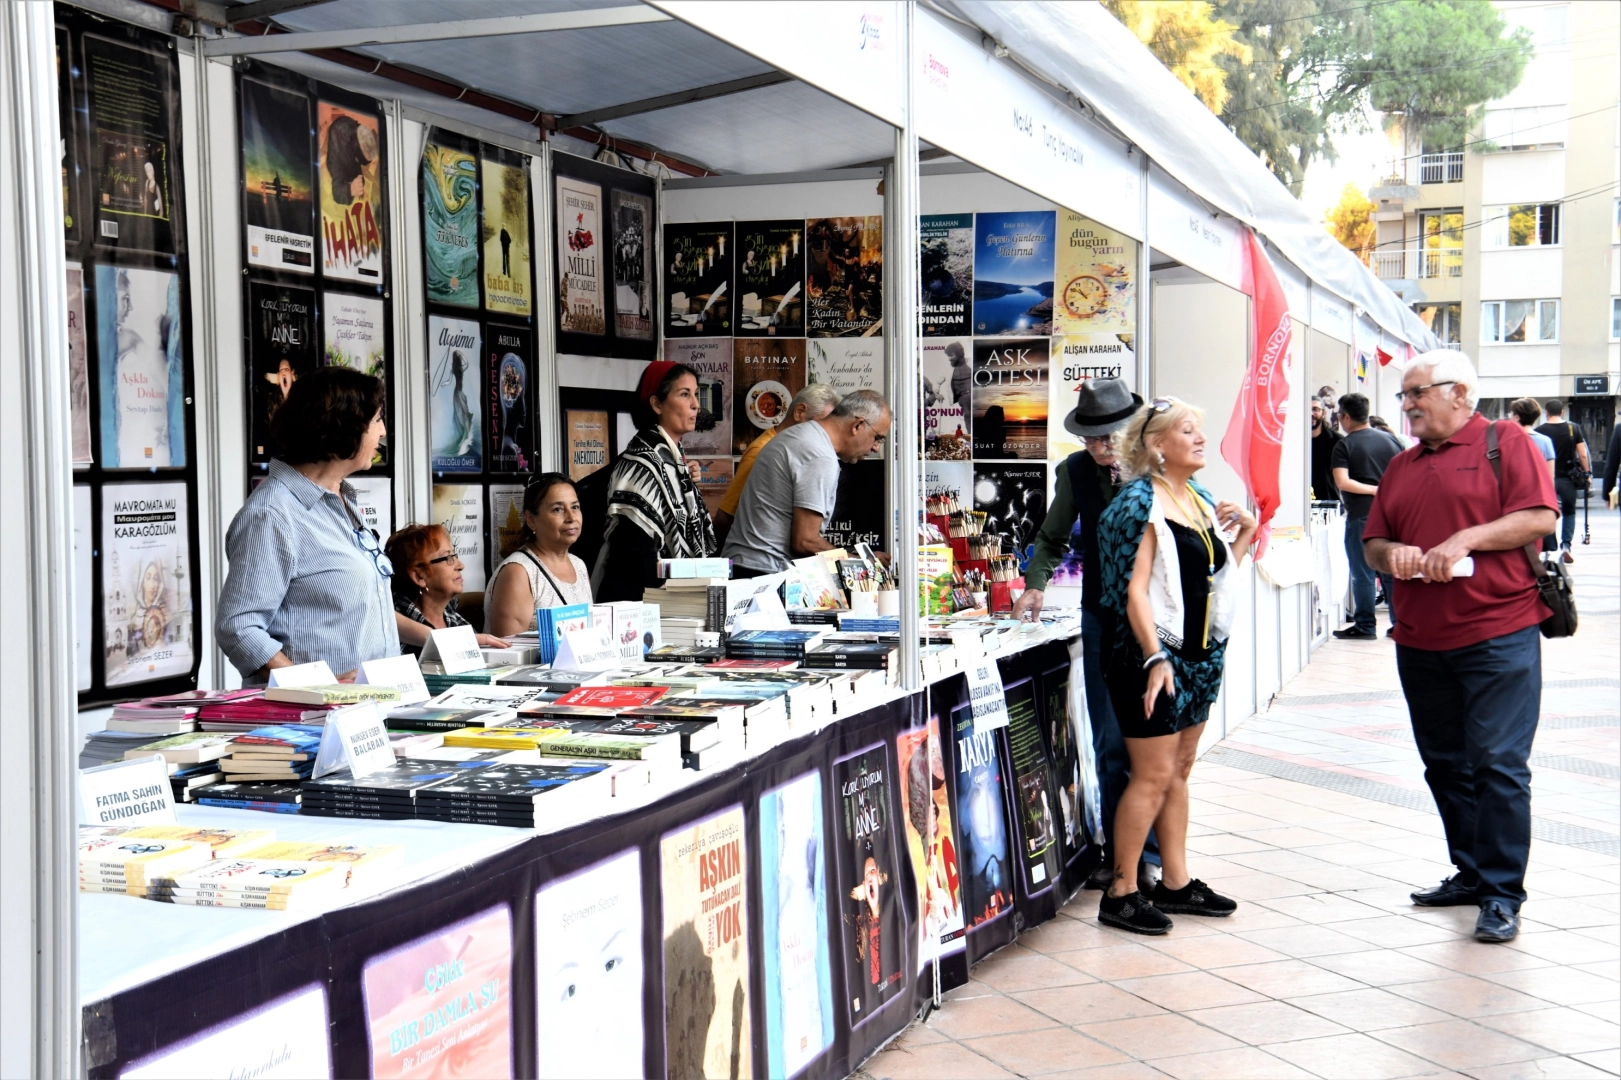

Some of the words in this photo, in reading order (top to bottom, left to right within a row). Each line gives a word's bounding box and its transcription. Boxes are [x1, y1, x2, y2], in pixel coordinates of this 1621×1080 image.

[931, 220, 959, 228] KARAHAN
[1012, 232, 1046, 243] Günlerin
[1072, 229, 1094, 238] dün
[1069, 237, 1108, 248] bugün
[1092, 245, 1124, 257] yarın
[568, 253, 595, 277] MİLLİ
[486, 273, 510, 292] baba
[568, 276, 596, 292] MÜCADELE
[812, 298, 829, 308] Her
[812, 309, 841, 318] Kadın
[812, 319, 828, 329] Bir
[272, 324, 300, 344] ANNE
[1064, 345, 1088, 355] ALİŞAN
[1089, 344, 1122, 354] KARAHAN
[744, 356, 797, 365] BATINAY
[859, 376, 873, 387] Var
[974, 365, 1042, 387] ÖTESİ
[491, 353, 500, 450] PESENT
[461, 457, 475, 467] ÖMER
[114, 499, 163, 512] MAVROMATA
[165, 498, 176, 509] MU
[155, 650, 173, 662] SEZER
[620, 644, 638, 659] MİLLİ
[369, 726, 381, 738] ESER
[353, 737, 385, 756] BALABAN
[958, 730, 996, 778] KARYA
[95, 790, 131, 808] FATMA
[99, 799, 166, 823] GÜNDOĞAN
[856, 805, 879, 840] ANNE
[700, 838, 741, 895] AŞKIN
[701, 886, 730, 914] TUTUNACAK
[731, 881, 741, 899] DALI
[716, 900, 741, 948] YOK
[424, 958, 465, 998] Çölde
[389, 1020, 420, 1056] BİR
[423, 992, 478, 1038] DAMLA
[481, 978, 499, 1008] SU
[402, 1057, 414, 1072] Bir
[416, 1045, 441, 1064] Tanesi
[442, 1035, 457, 1051] Seni
